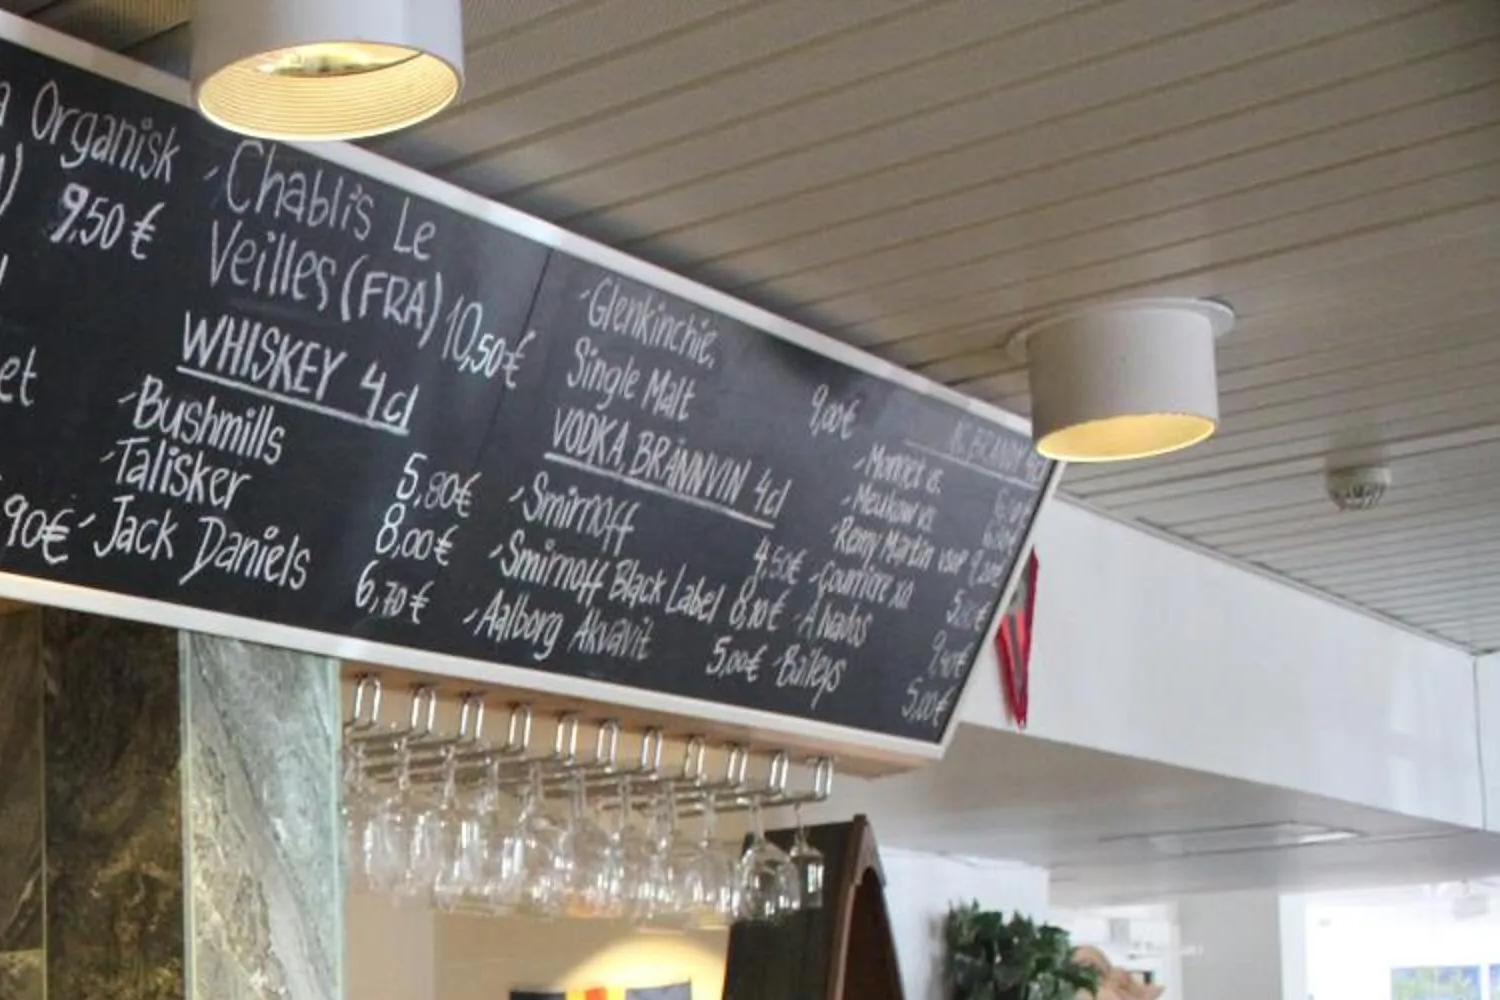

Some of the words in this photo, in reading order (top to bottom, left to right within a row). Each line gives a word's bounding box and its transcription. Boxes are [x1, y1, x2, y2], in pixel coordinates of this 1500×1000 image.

[31, 81, 181, 184] Organisk
[394, 198, 437, 261] Le
[180, 310, 348, 401] WHISKEY
[359, 362, 419, 430] 4cl
[566, 336, 637, 411] Single
[641, 368, 696, 423] Malt
[179, 515, 311, 591] Daniels
